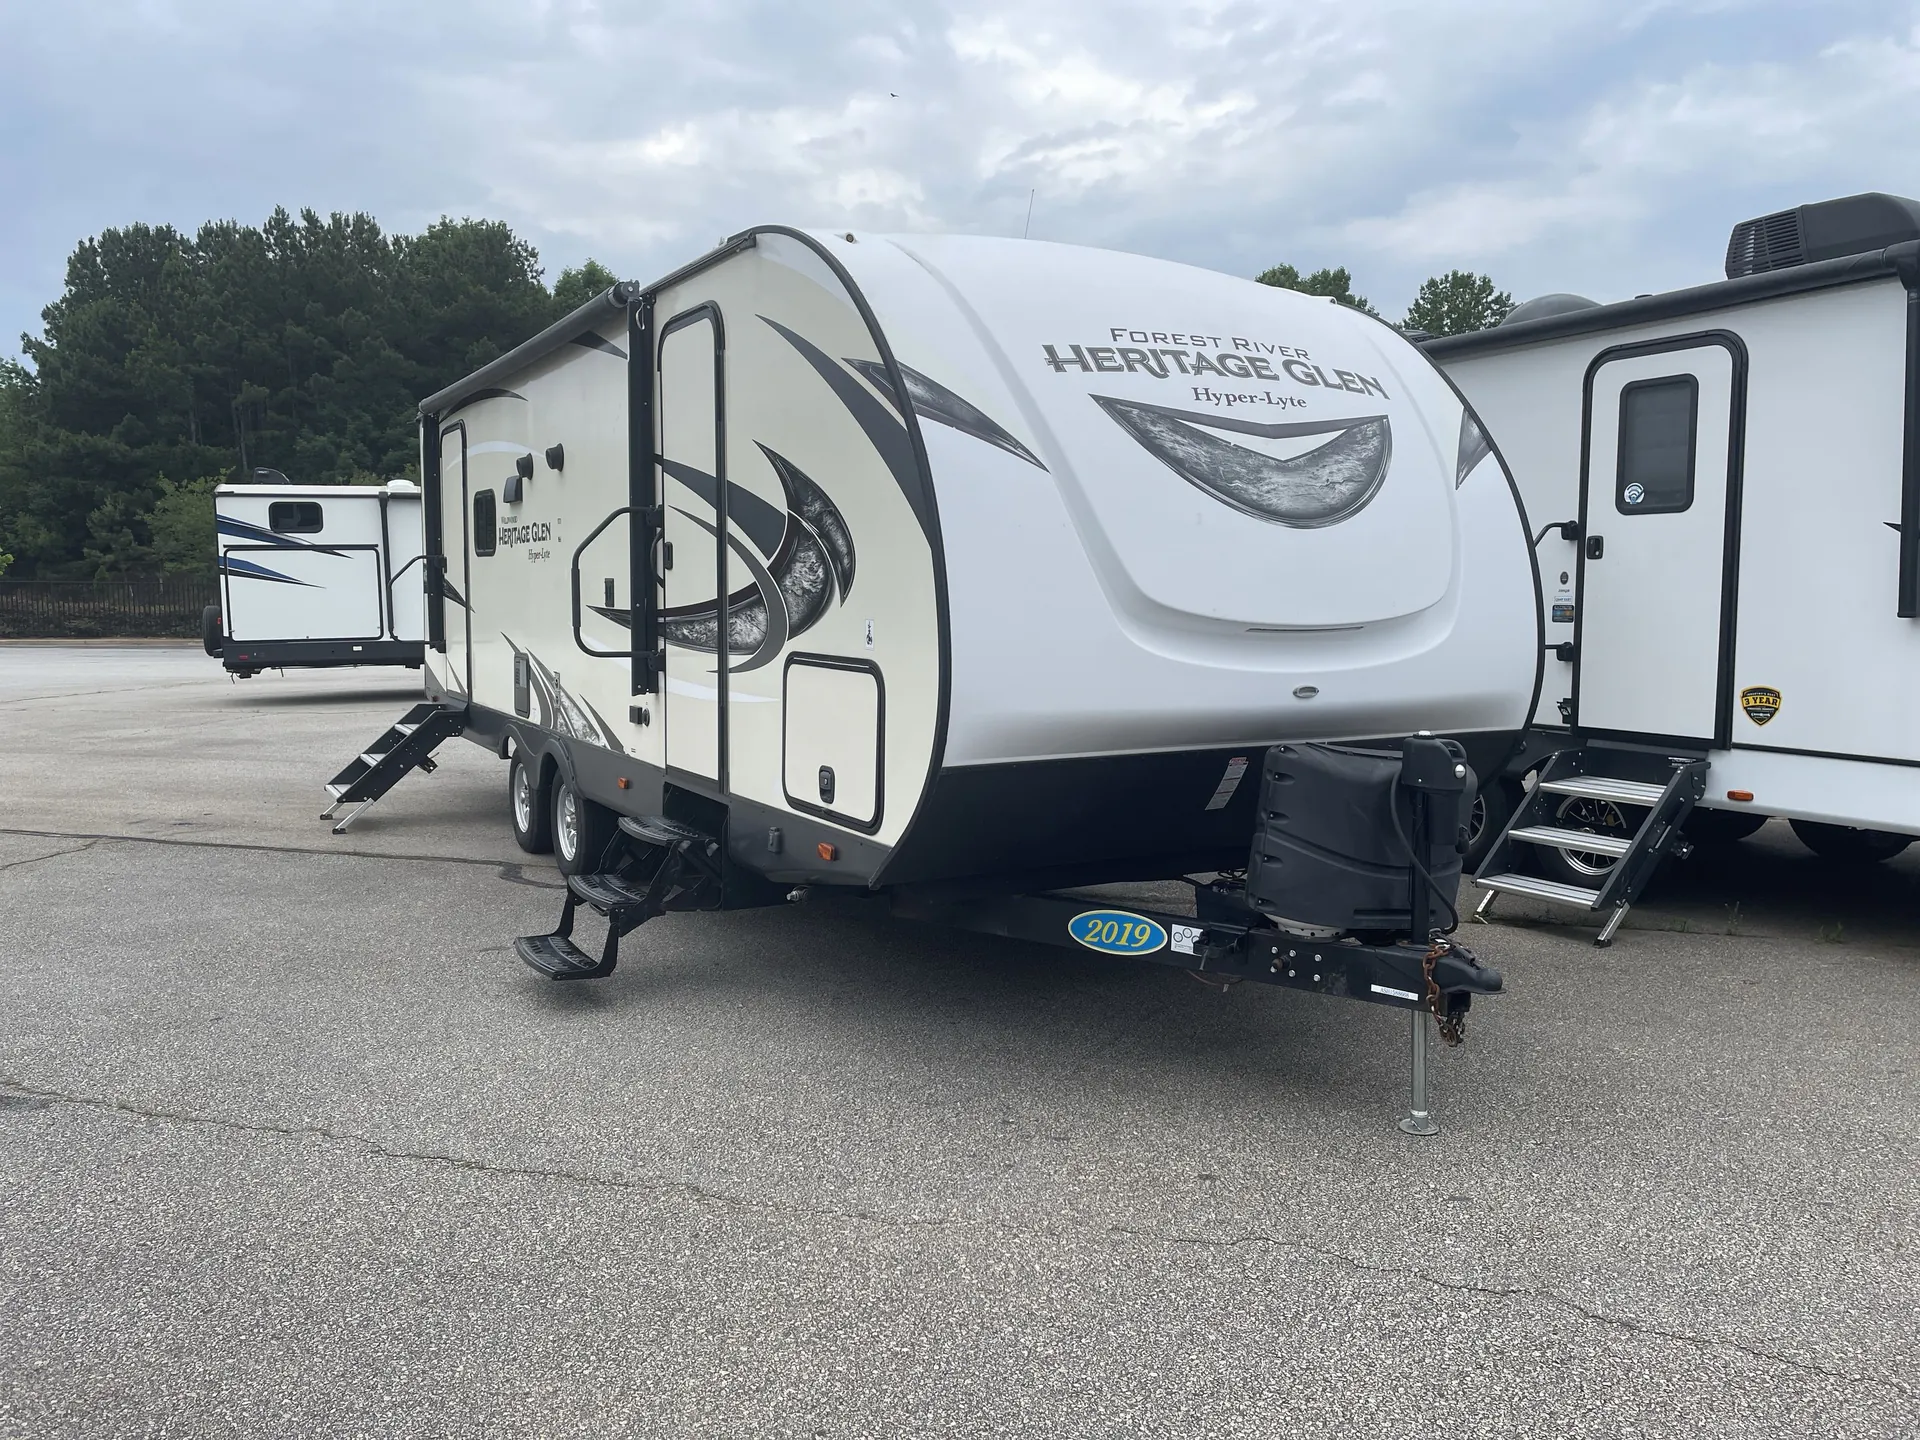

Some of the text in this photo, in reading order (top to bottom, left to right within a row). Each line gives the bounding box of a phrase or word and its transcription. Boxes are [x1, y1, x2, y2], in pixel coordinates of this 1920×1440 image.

[1110, 327, 1311, 361] FOREST RIVER
[1042, 343, 1391, 400] HERITAGE GLEN
[1191, 386, 1307, 410] Hyper-Lyte
[498, 522, 551, 548] HERITAGE GLEN
[1752, 697, 1778, 706] YEAR
[1083, 919, 1151, 948] 2019
